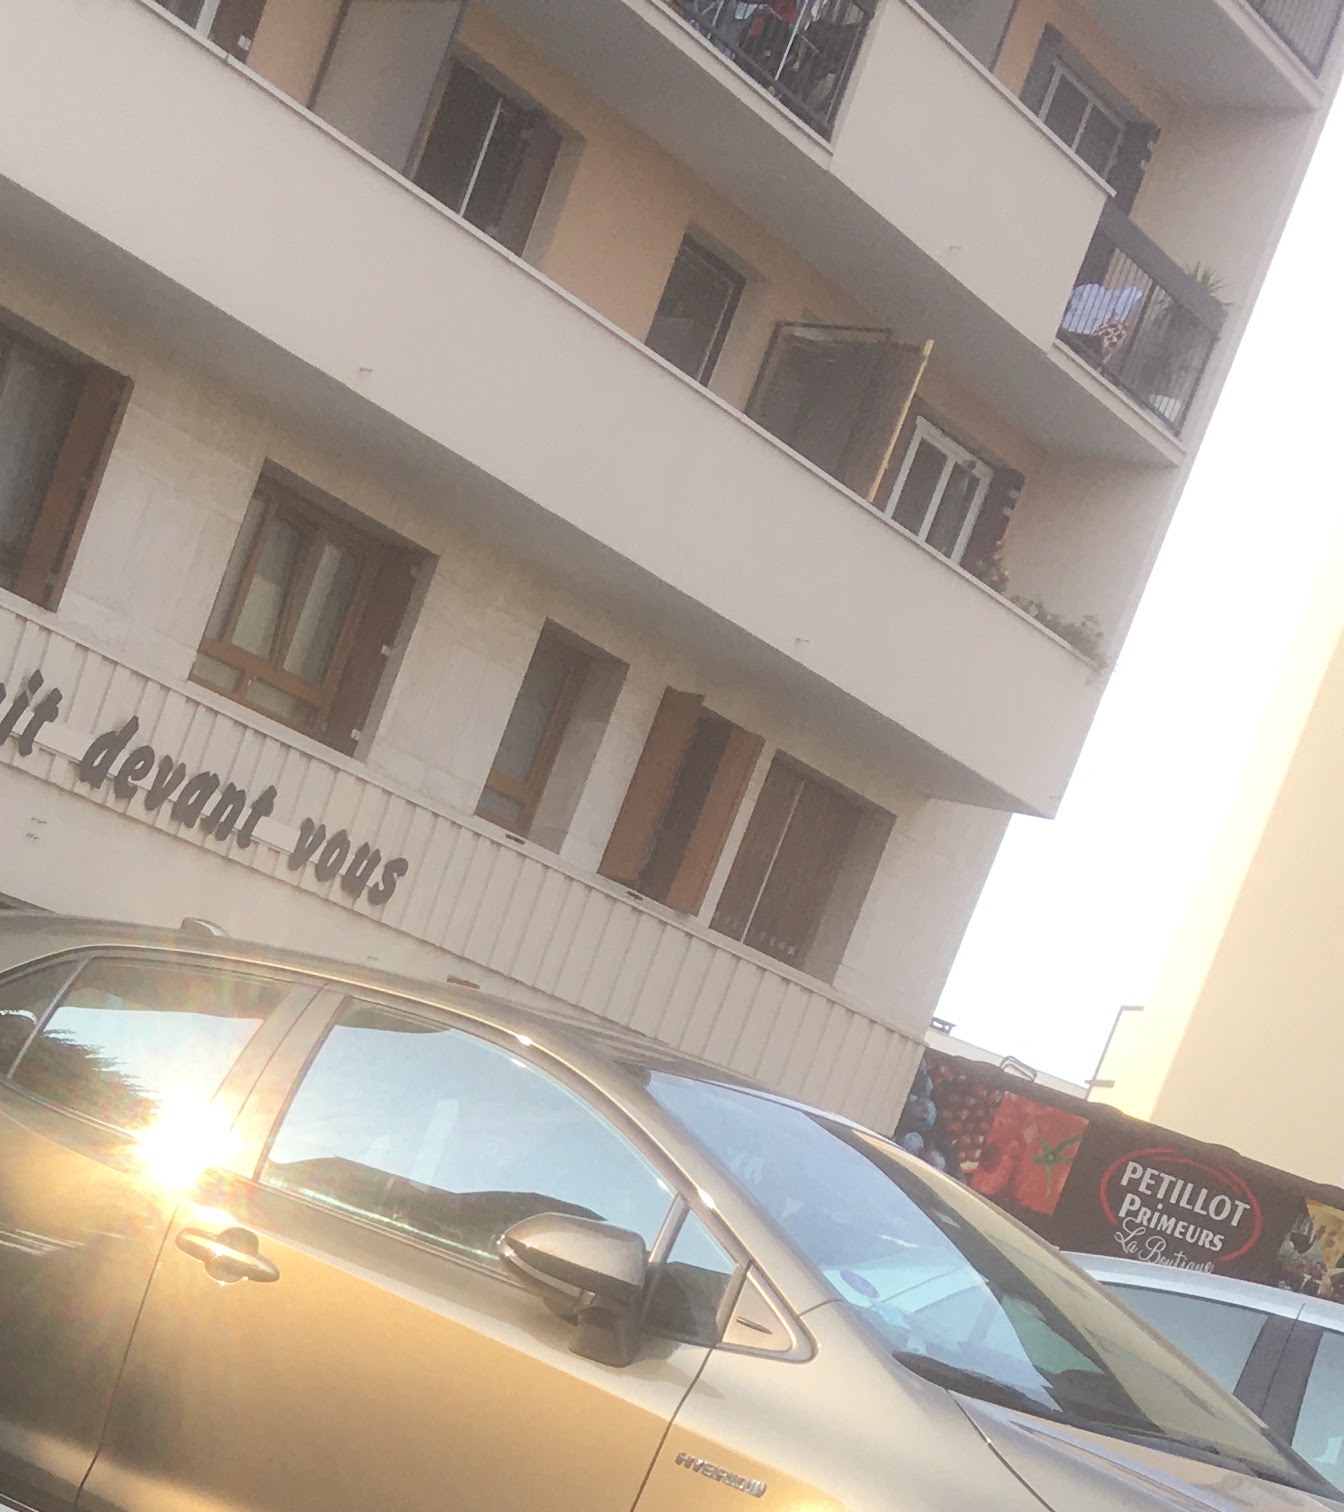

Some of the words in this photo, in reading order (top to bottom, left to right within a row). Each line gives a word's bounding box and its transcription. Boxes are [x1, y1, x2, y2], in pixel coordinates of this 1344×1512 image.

[78, 716, 278, 849] devant
[287, 817, 409, 906] vous
[1120, 1161, 1251, 1227] PETILLOT
[1114, 1217, 1146, 1254] La
